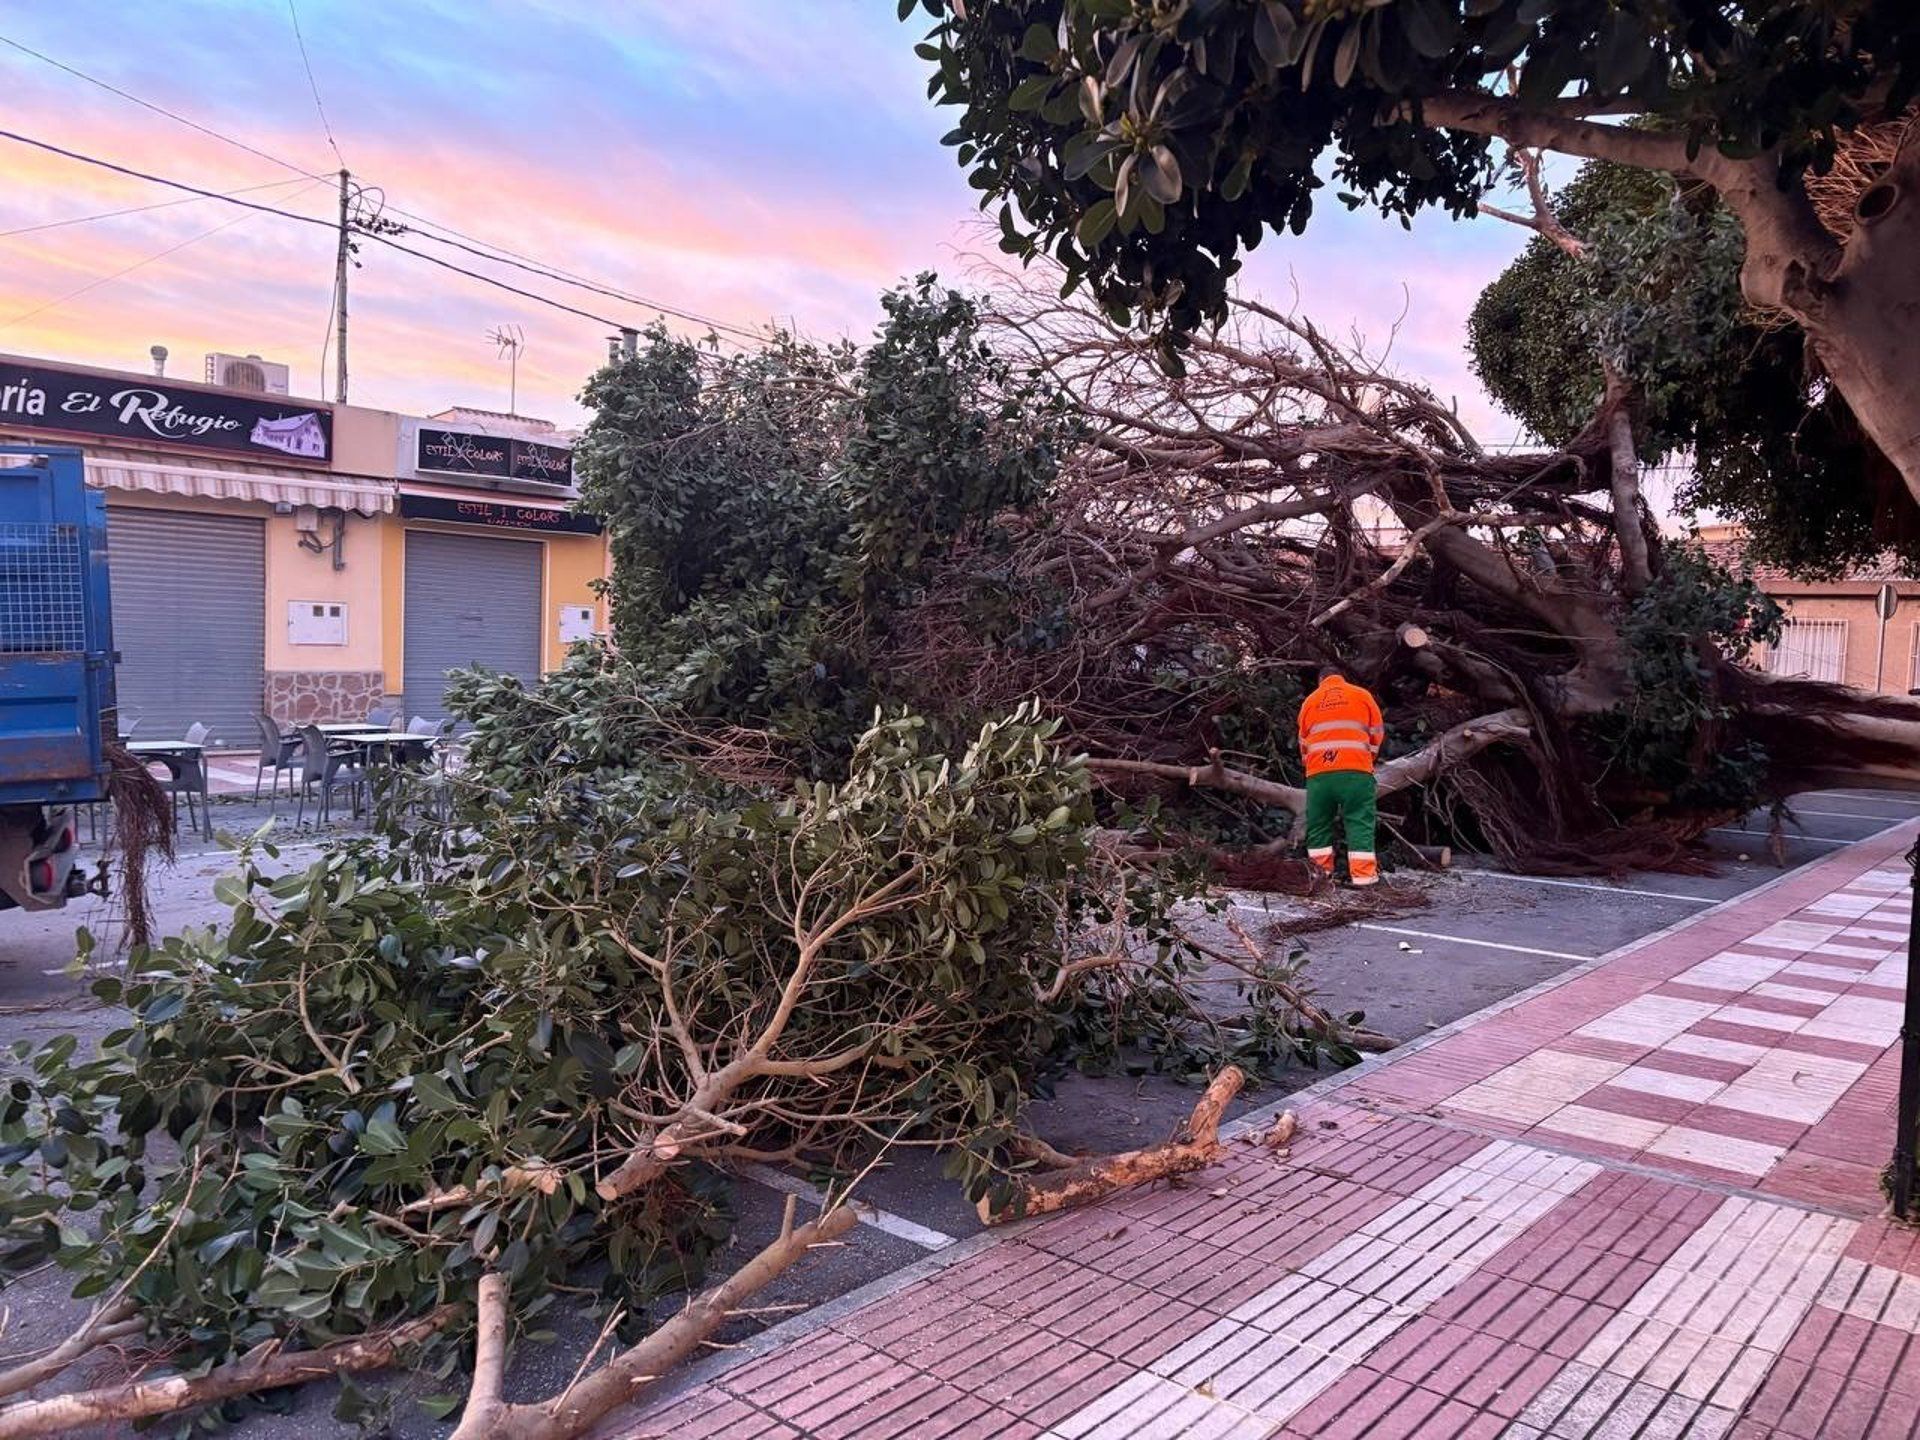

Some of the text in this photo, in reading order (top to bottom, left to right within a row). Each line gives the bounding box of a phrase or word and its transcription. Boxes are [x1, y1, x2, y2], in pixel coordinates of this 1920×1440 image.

[0, 378, 242, 438] ría El Refugio
[466, 448, 504, 463] COLORS
[457, 503, 492, 516] ESTIL
[516, 509, 560, 523] COLORS
